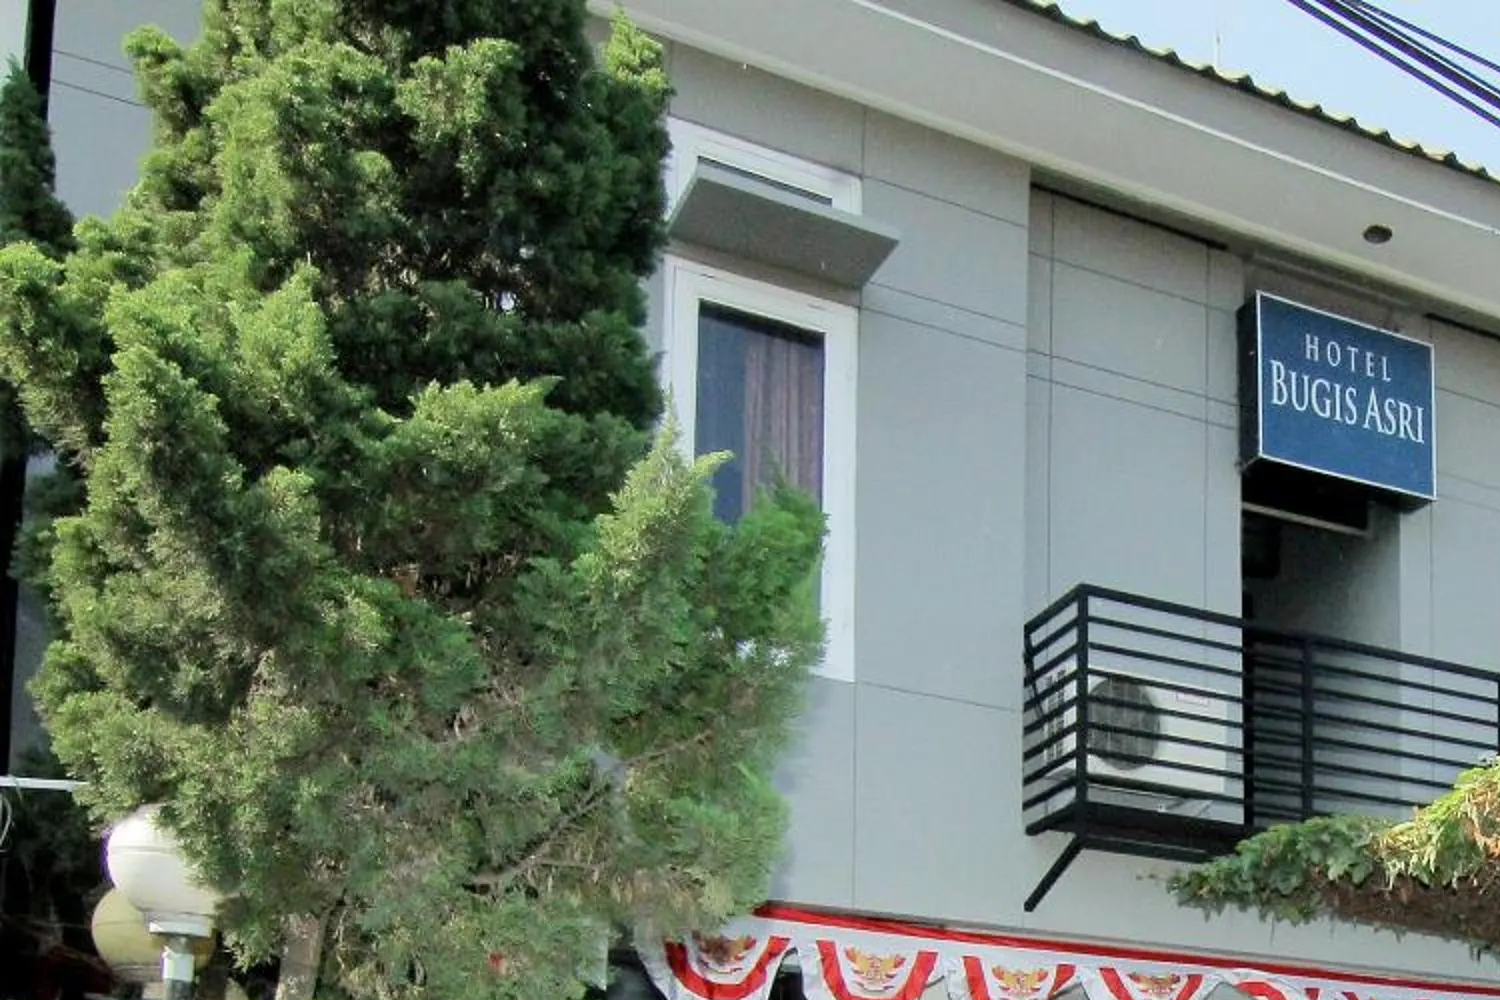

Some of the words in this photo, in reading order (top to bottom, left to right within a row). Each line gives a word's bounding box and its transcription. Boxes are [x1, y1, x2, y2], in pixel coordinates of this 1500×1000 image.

[1305, 333, 1392, 383] HOTEL
[1270, 359, 1358, 425] BUGIS
[1362, 387, 1425, 444] ASRI
